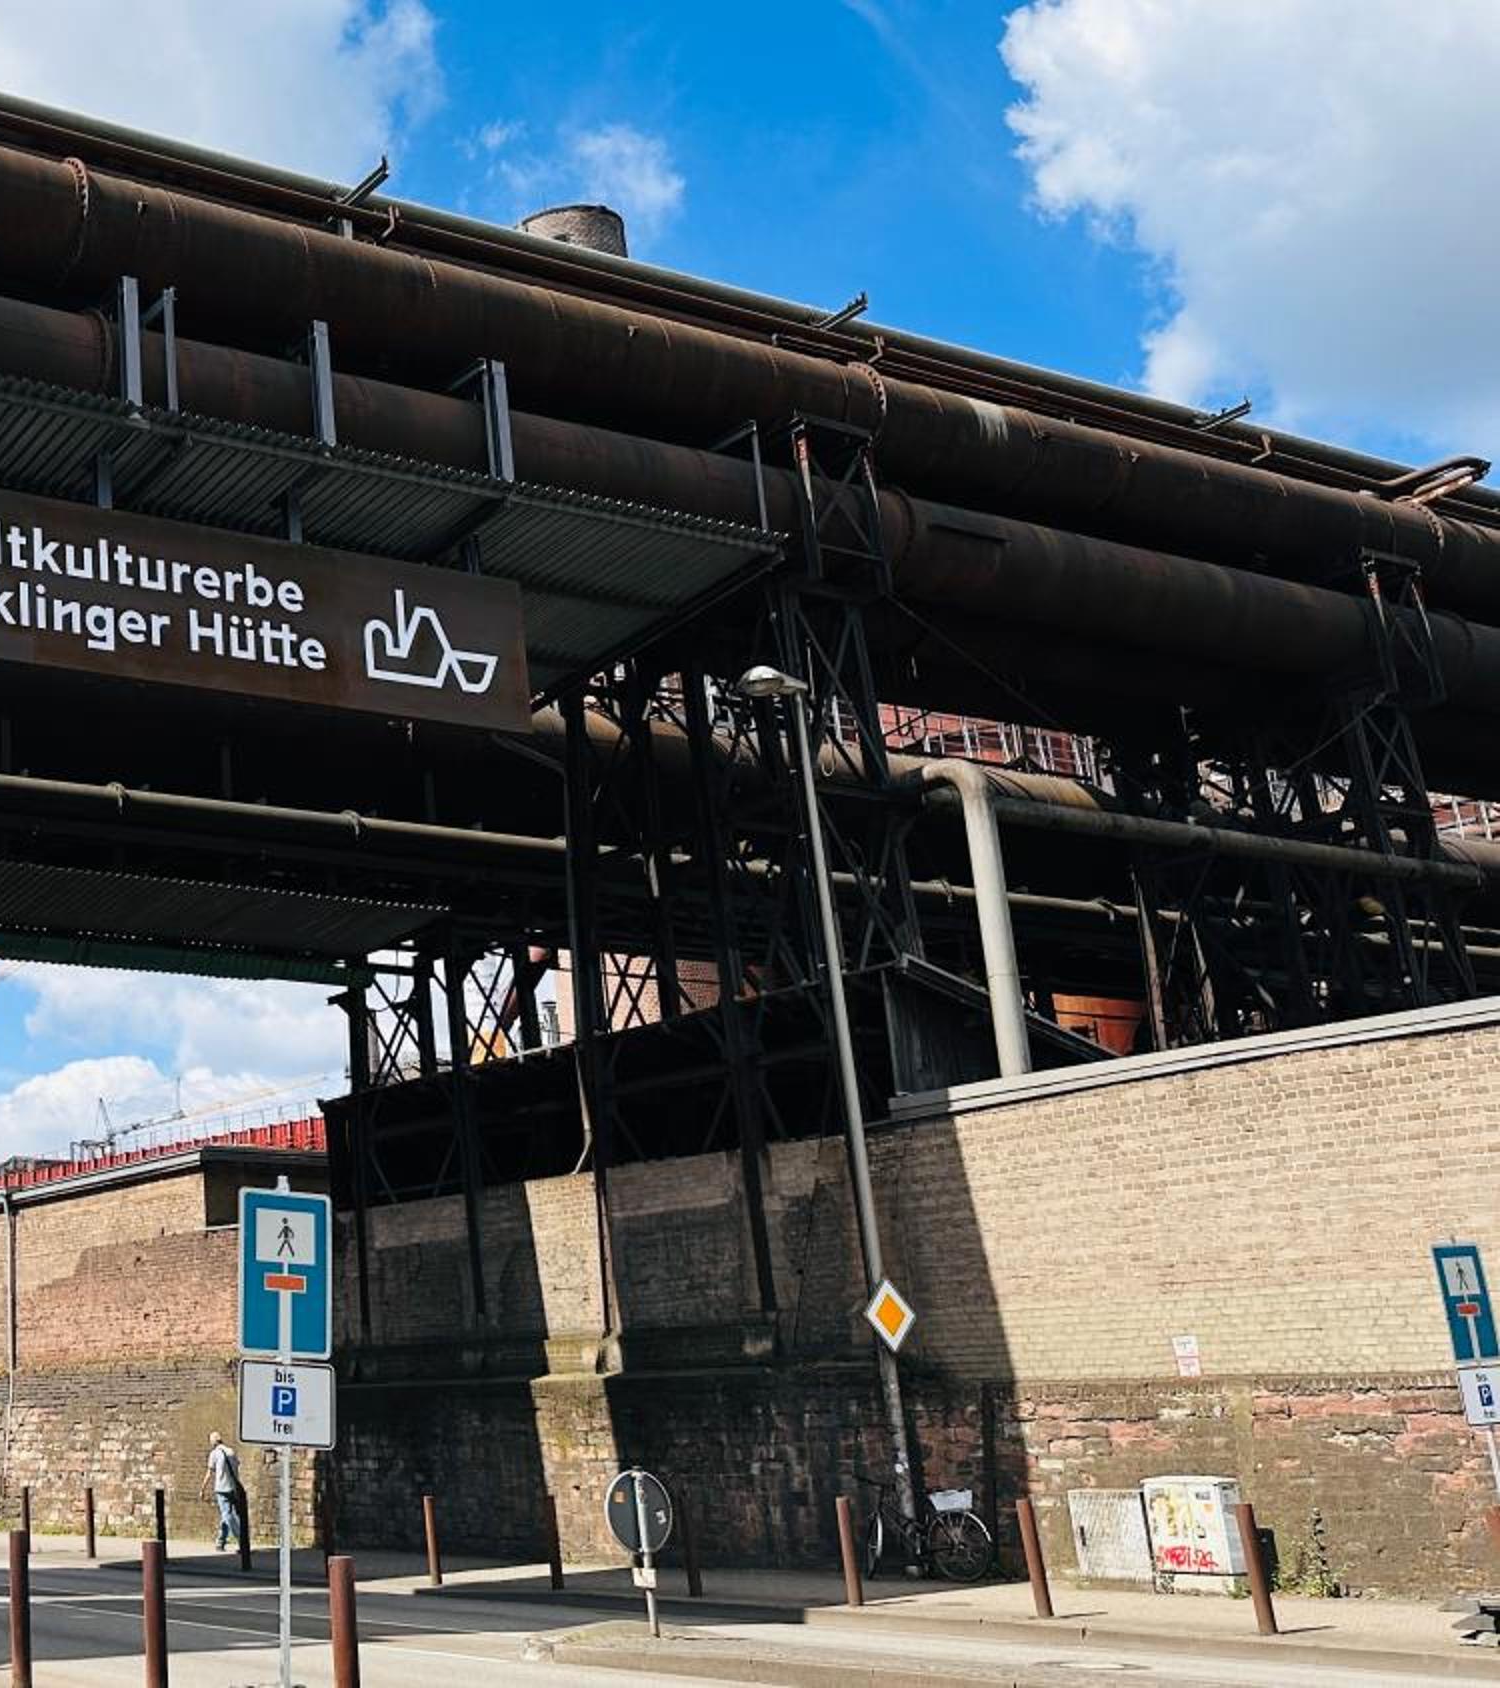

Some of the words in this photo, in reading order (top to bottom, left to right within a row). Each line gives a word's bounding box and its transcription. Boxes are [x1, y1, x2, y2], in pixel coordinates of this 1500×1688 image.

[189, 608, 327, 671] Hütte
[274, 1368, 295, 1384] bis
[277, 1389, 293, 1413] P
[273, 1418, 293, 1435] frei
